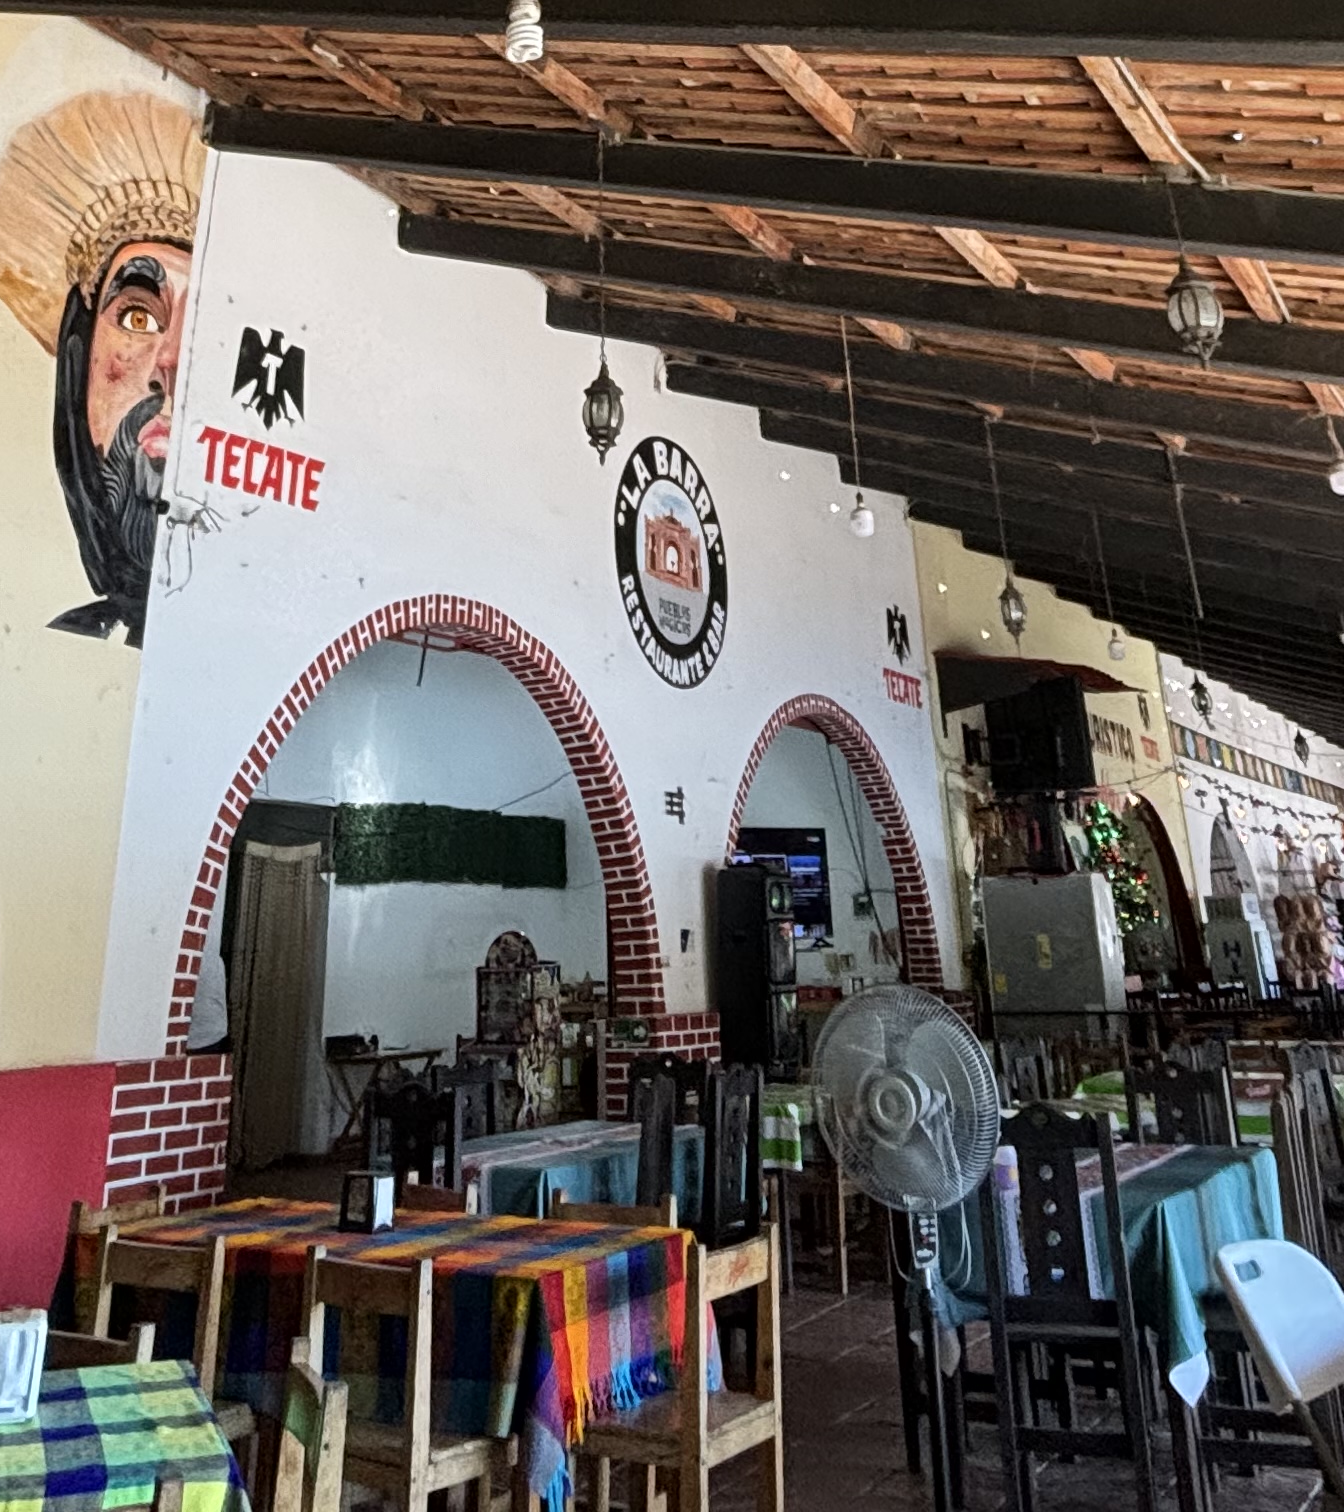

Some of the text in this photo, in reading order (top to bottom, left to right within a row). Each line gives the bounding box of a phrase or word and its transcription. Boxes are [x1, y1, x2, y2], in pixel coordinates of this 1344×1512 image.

[196, 425, 326, 512] TECATE
[621, 440, 720, 550] LA BARRA
[621, 574, 705, 686] RESTAURANTE
[706, 601, 725, 655] BAR
[882, 667, 923, 710] TECATE
